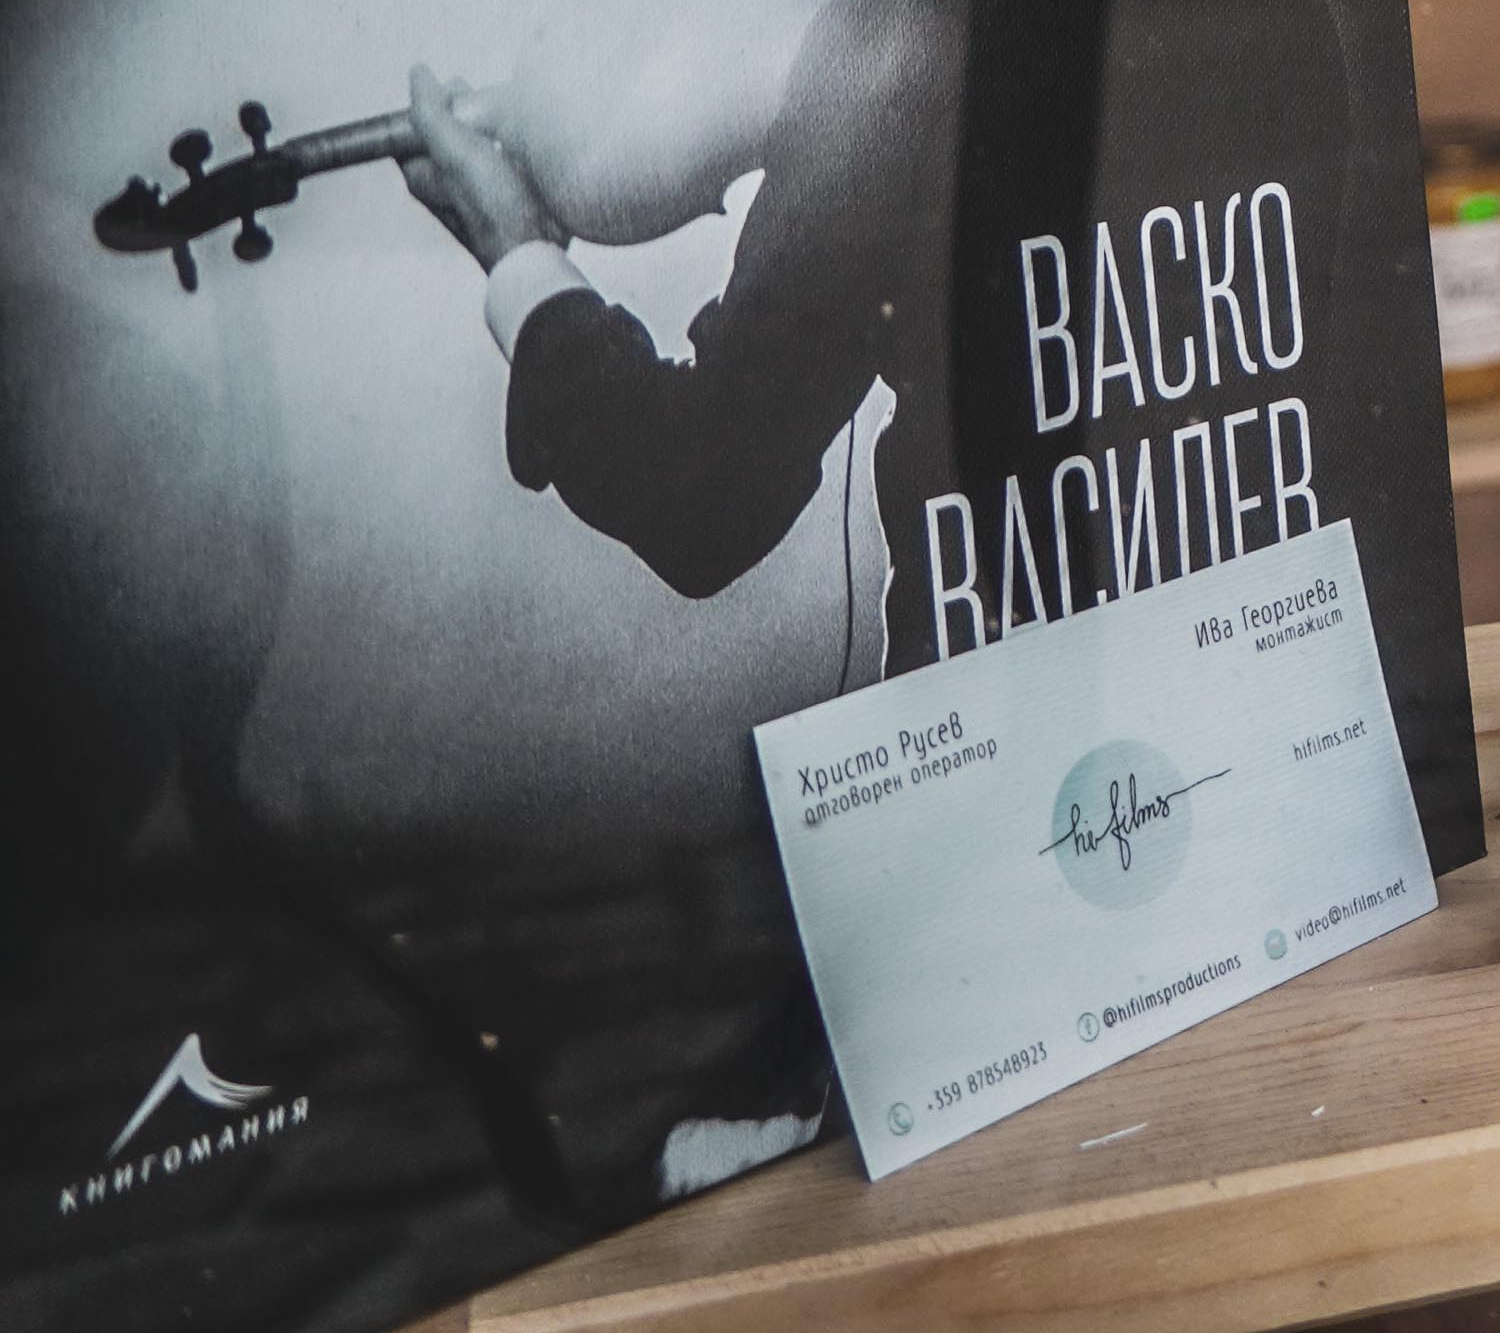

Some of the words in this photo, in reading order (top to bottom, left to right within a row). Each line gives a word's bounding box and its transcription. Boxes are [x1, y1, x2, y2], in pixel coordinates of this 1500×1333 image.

[1020, 181, 1304, 434] ВАСКО
[1194, 616, 1234, 649] Ива
[1241, 578, 1338, 631] Георгиева
[1255, 608, 1343, 654] монтажист
[797, 745, 890, 798] Христо
[898, 711, 963, 760] Русев
[1292, 717, 1368, 761] hifilms.net
[804, 774, 904, 826] отговорен
[910, 738, 998, 784] оператор
[1294, 876, 1407, 942] video@hifilms.net
[1102, 953, 1242, 1029] @hifilmsproductions
[966, 1040, 1048, 1094] 878548923
[58, 1095, 310, 1215] КНИГОМАНИЯ
